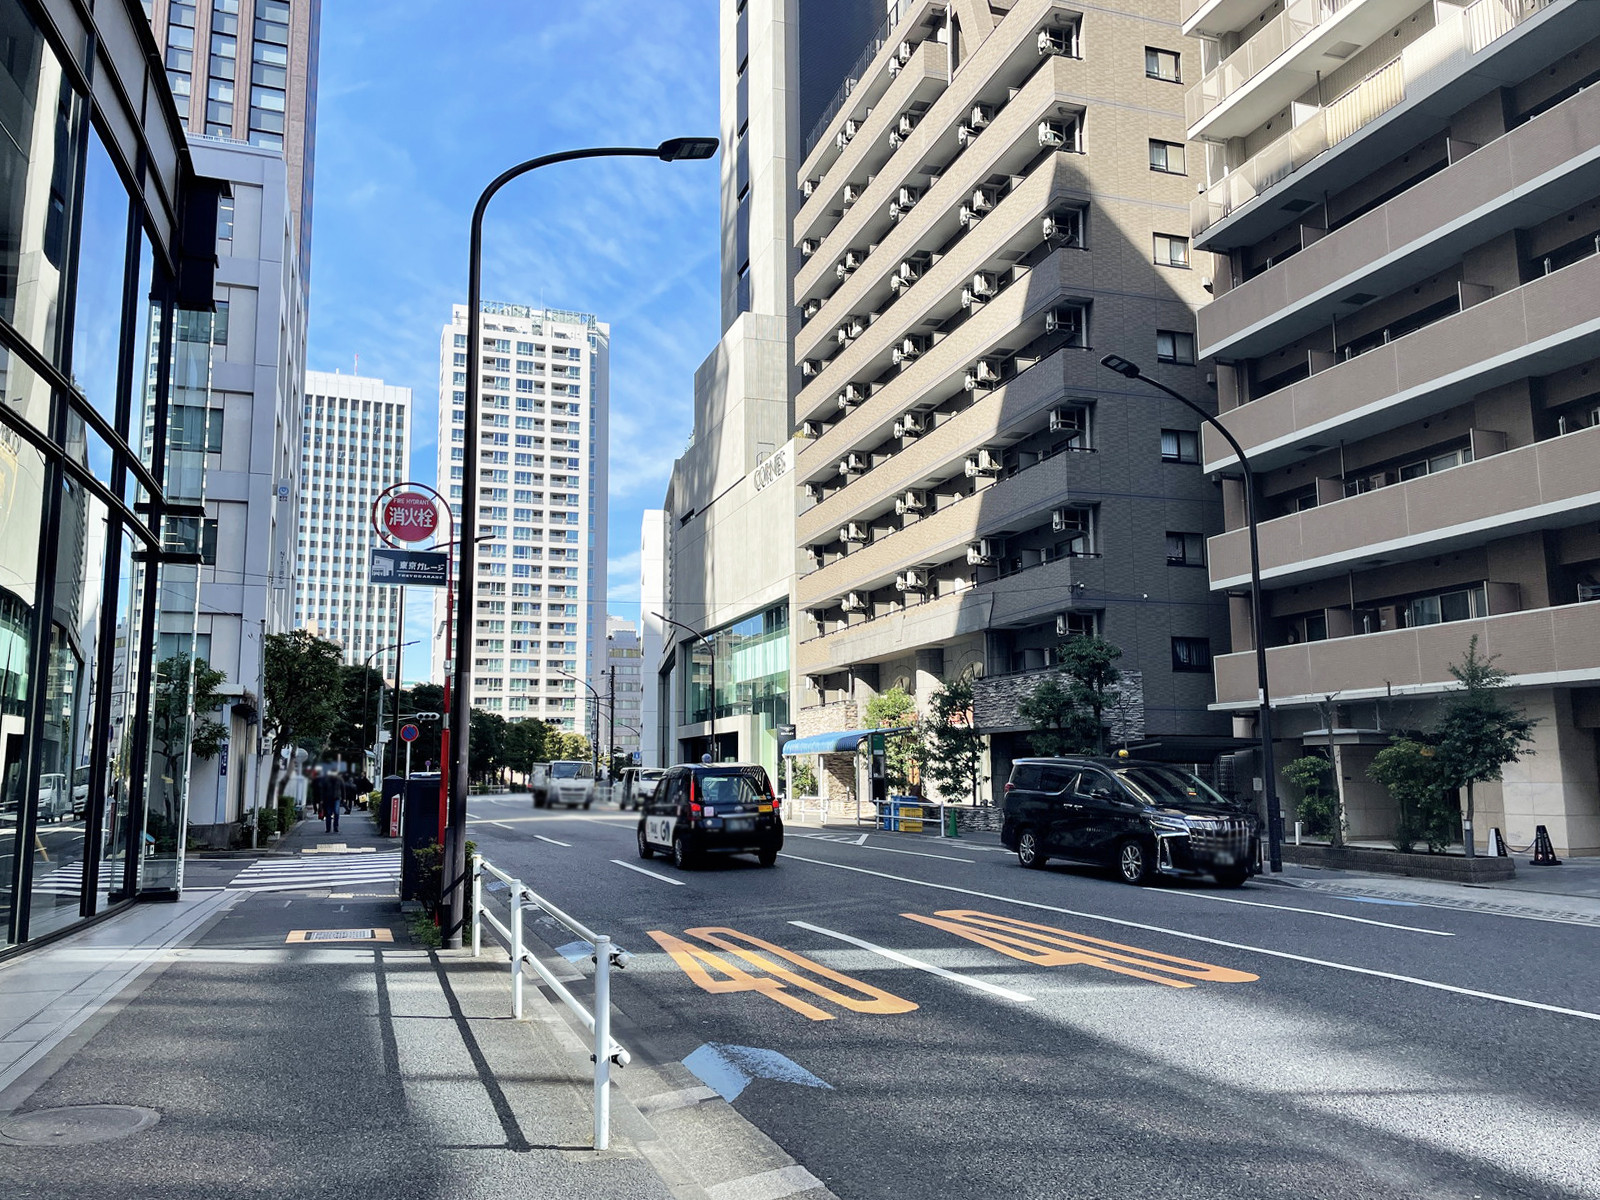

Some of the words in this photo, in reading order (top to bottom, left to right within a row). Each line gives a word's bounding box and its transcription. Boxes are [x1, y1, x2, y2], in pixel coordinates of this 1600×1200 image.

[754, 450, 786, 492] CORNES
[389, 506, 434, 528] 消火栓
[399, 560, 445, 571] 東京ガレージ
[900, 909, 1260, 989] 40
[647, 926, 919, 1021] 40
